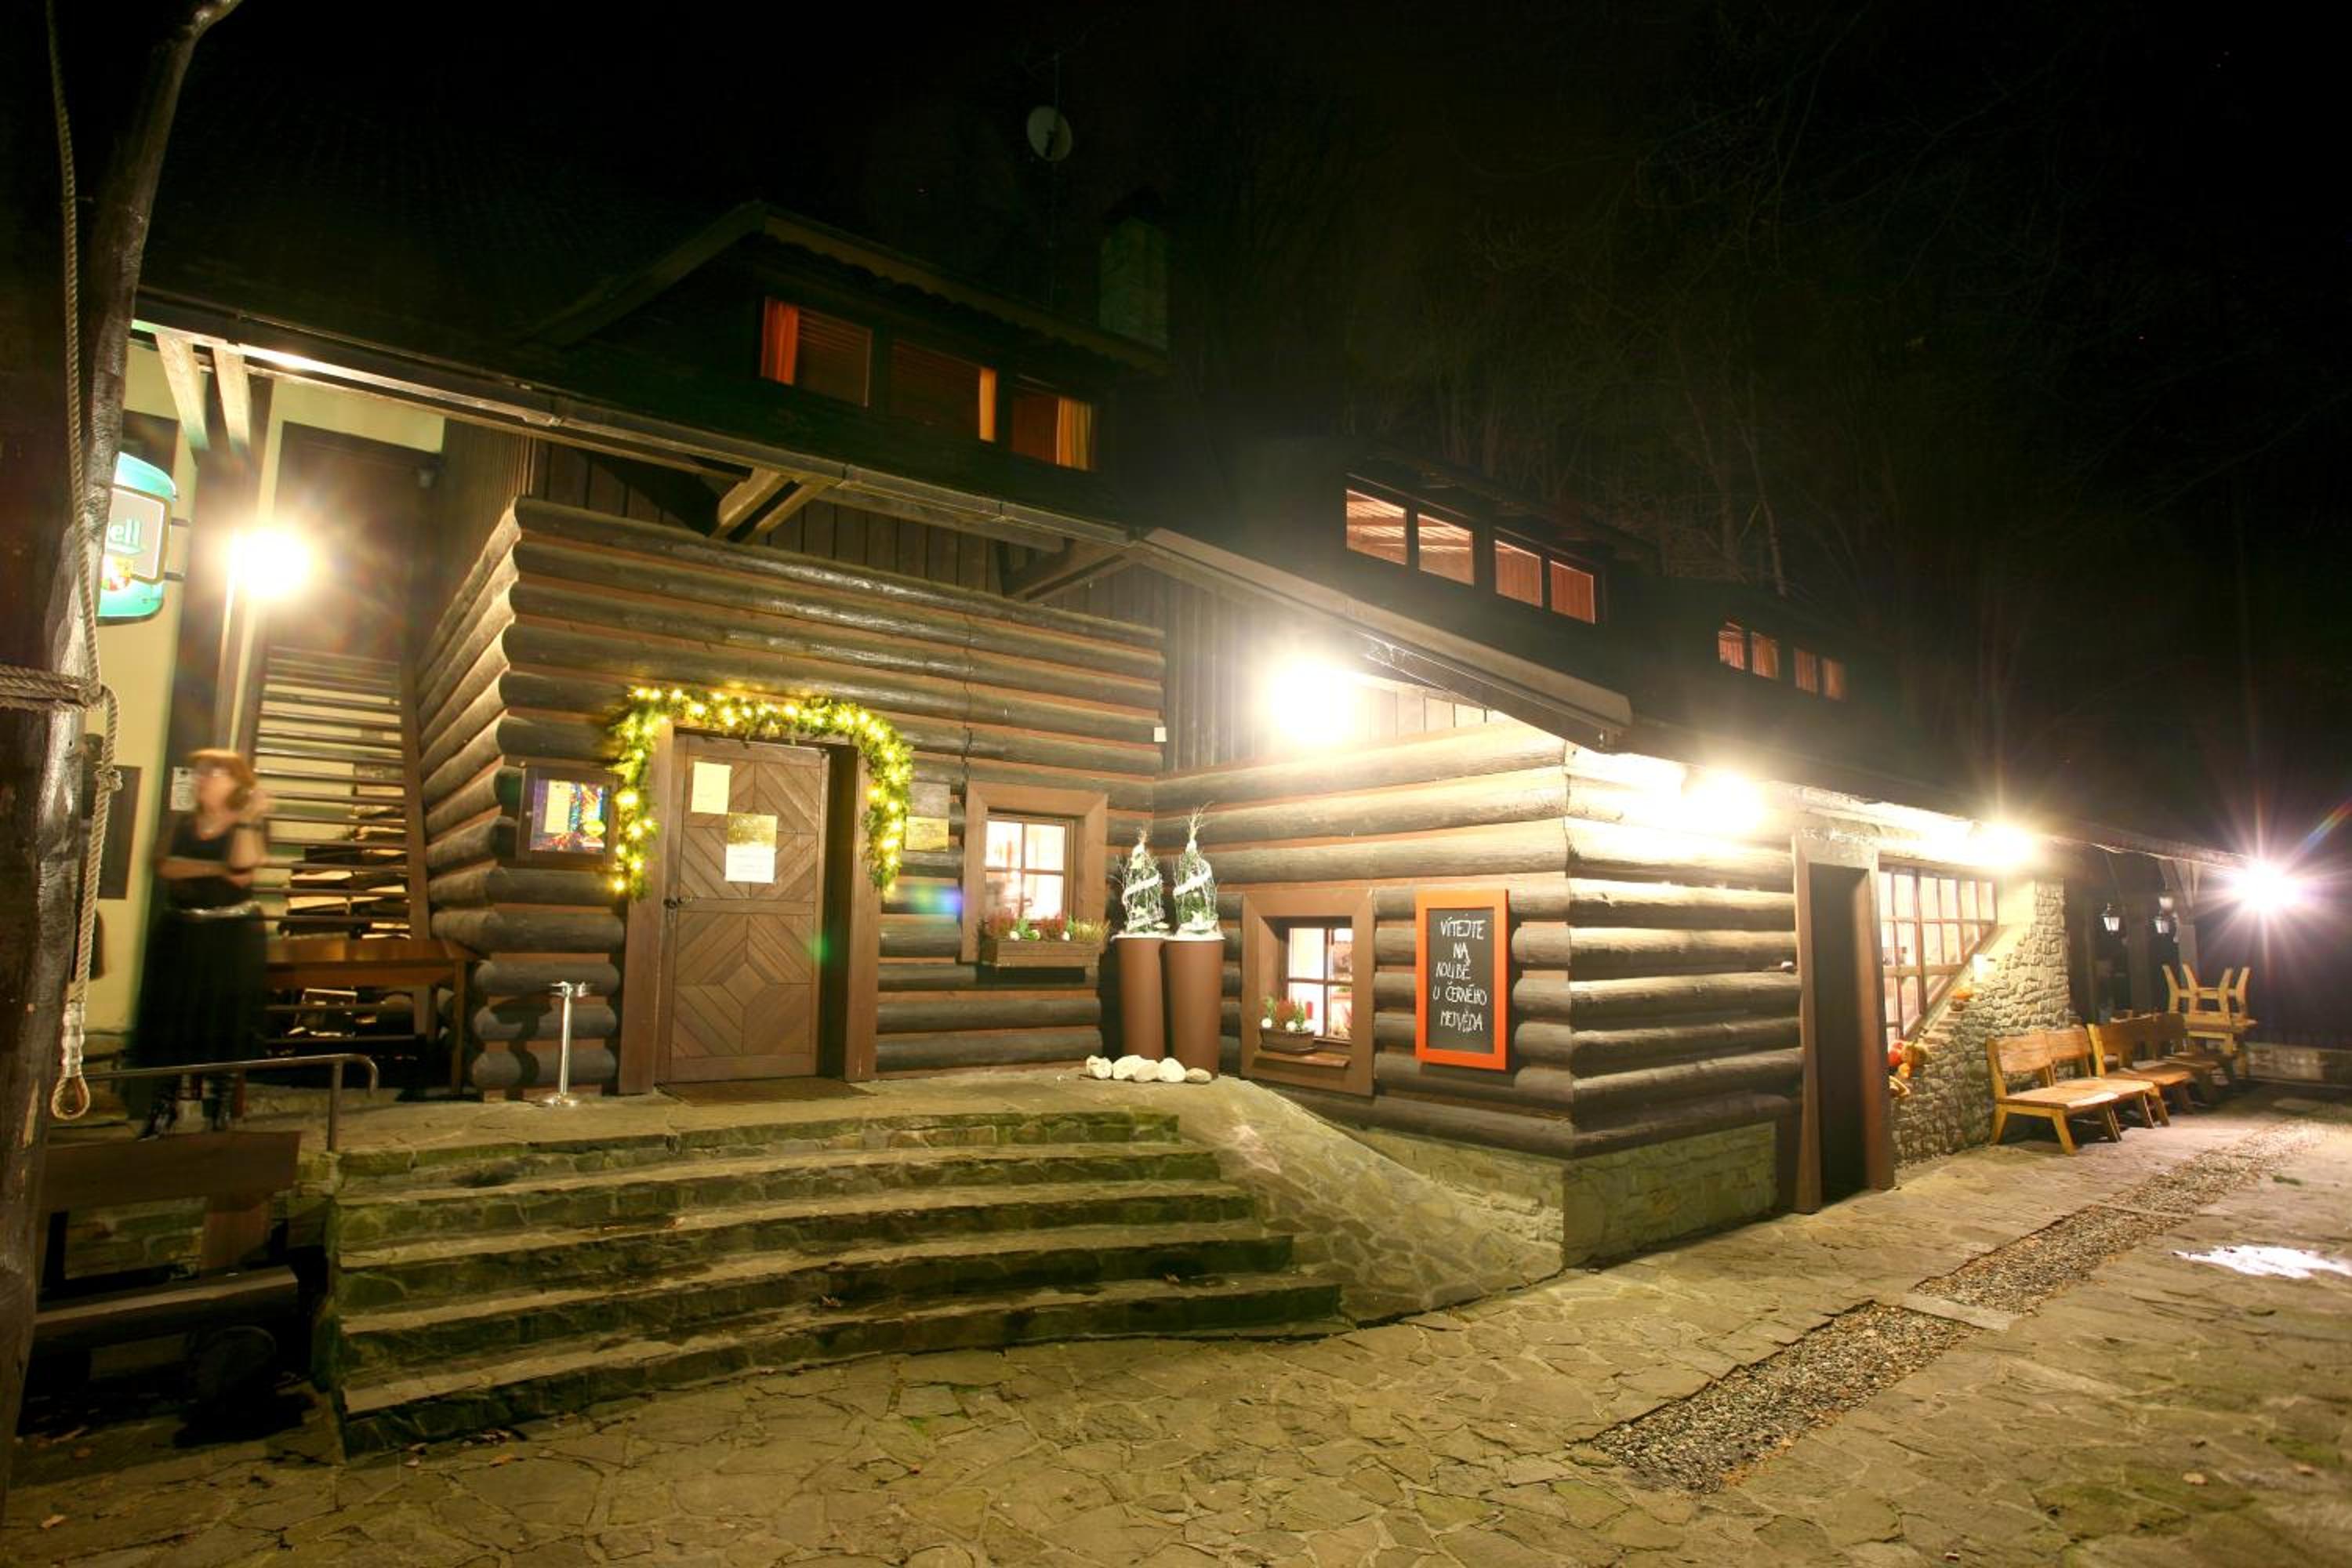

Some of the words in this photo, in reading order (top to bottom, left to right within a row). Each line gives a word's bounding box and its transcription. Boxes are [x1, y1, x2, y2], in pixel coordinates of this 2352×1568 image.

[108, 517, 140, 547] ell
[1440, 916, 1486, 940] VÍTEJTE
[1453, 942, 1470, 962] NA
[1432, 985, 1440, 1000] U
[1445, 981, 1487, 1006] ČERNÉHO
